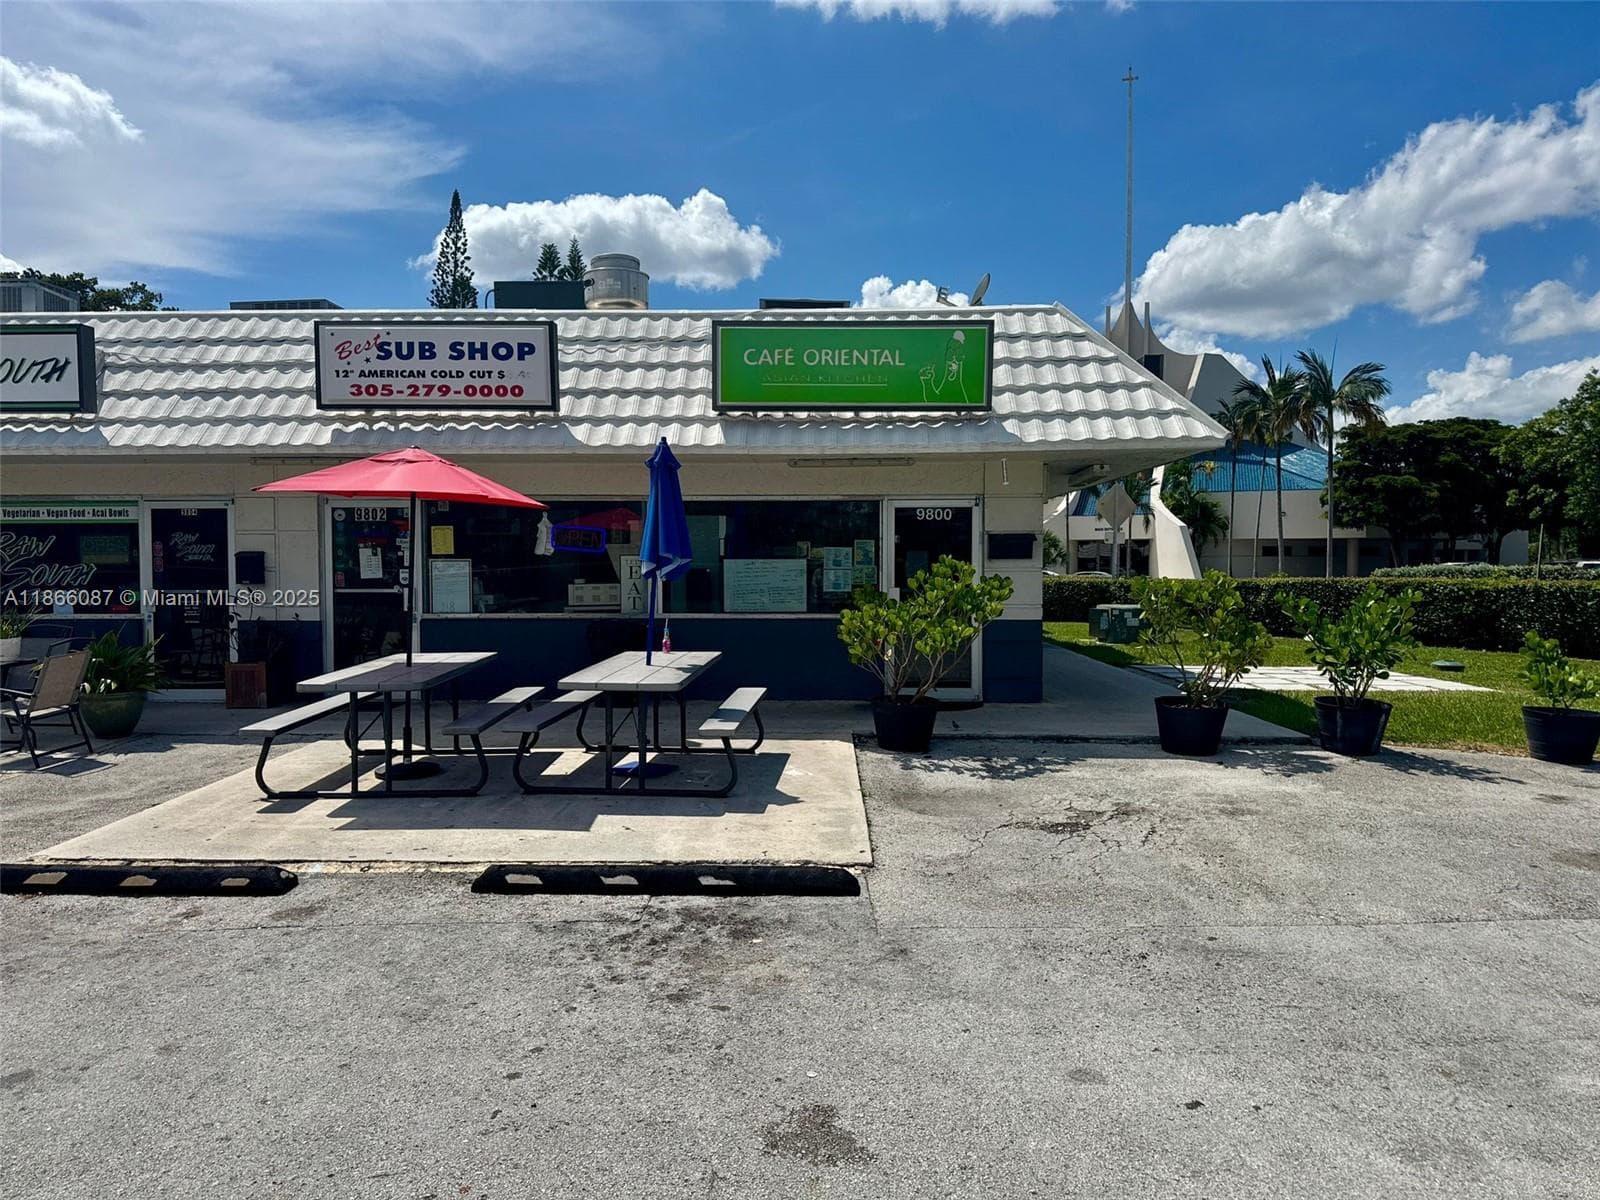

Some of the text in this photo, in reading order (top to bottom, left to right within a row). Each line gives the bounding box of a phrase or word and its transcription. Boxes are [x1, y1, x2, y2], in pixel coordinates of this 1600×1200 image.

[334, 333, 536, 361] Best SUB SHOP
[743, 347, 905, 366] CAFÉ ORIENTAL
[358, 369, 426, 379] AMERICAN
[430, 369, 464, 379] COLD
[469, 369, 493, 379] CUT
[349, 384, 525, 398] 305-279-0000
[2, 508, 41, 519] Vegetarian
[46, 508, 68, 519] Vegan
[69, 508, 86, 518] Food
[108, 508, 130, 518] Bowls
[355, 507, 386, 521] 9802
[916, 508, 952, 521] 9800
